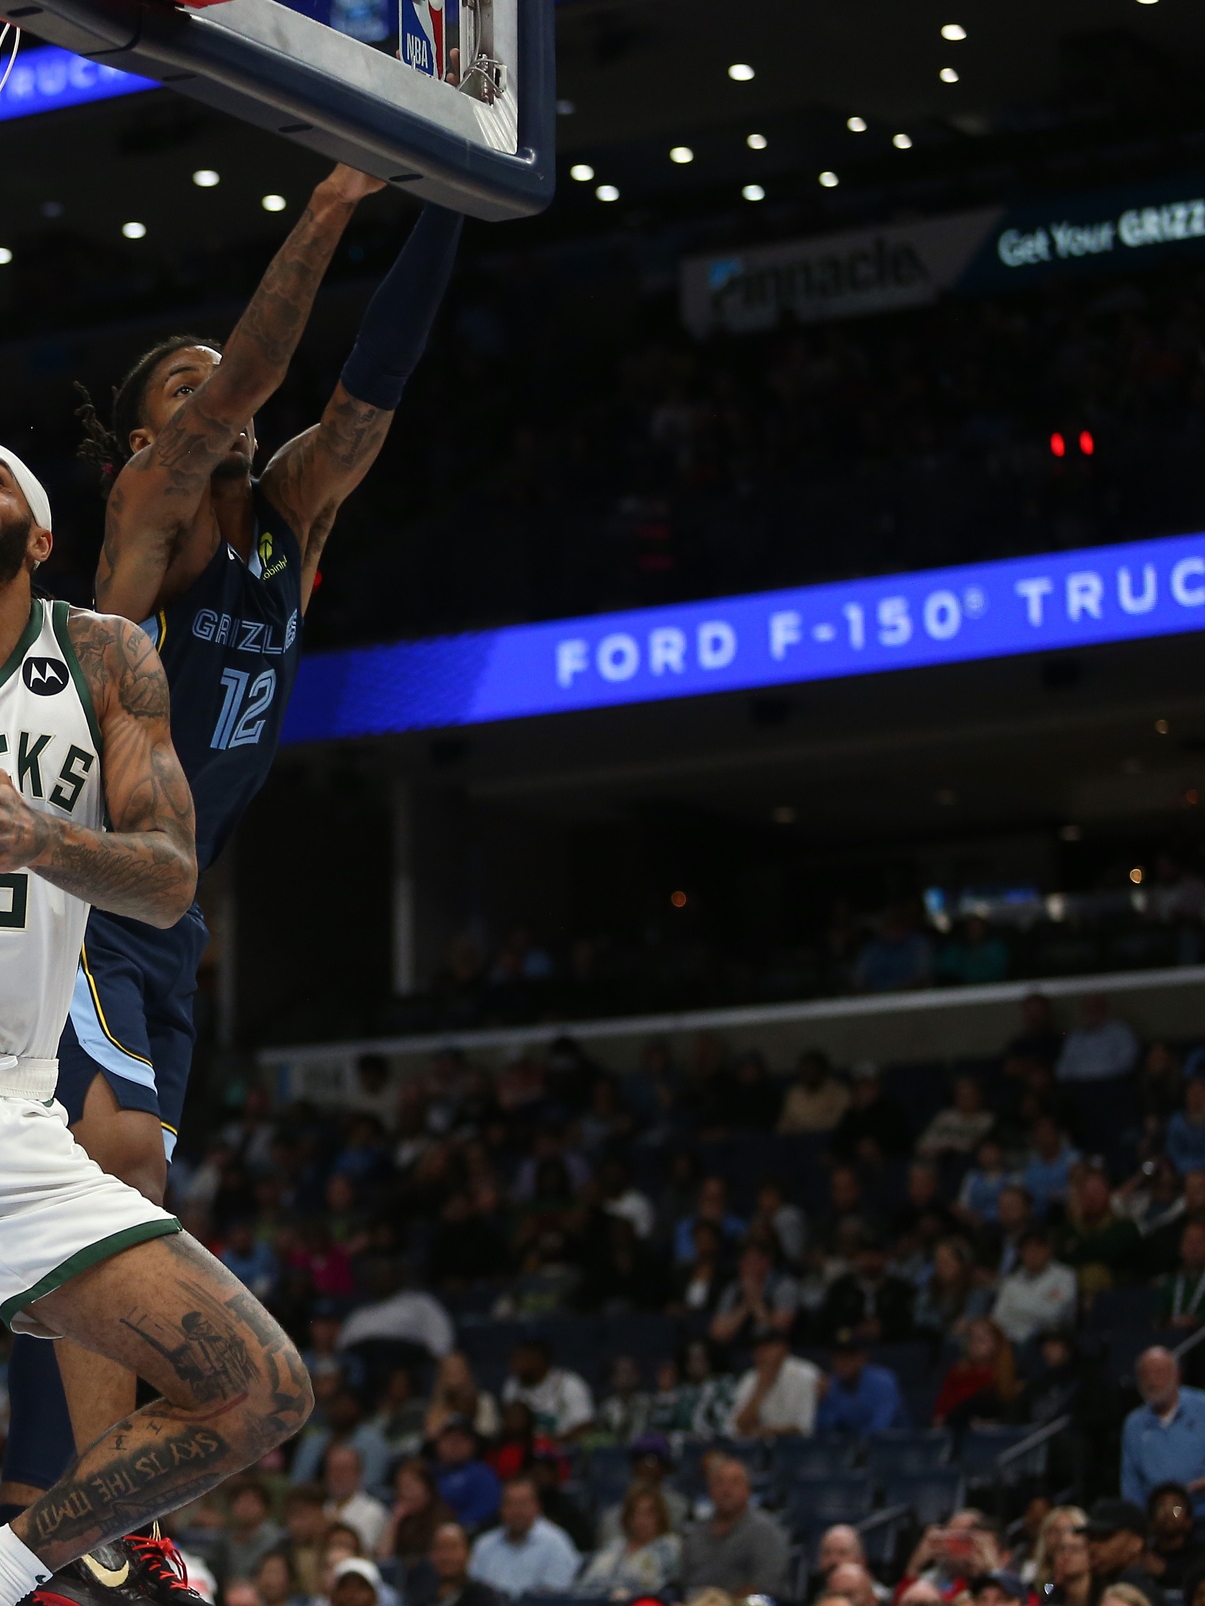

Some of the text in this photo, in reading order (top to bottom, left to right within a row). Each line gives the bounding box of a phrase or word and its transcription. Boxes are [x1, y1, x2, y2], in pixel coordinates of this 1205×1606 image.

[406, 32, 429, 69] NBA
[998, 227, 1051, 266] Get
[1050, 220, 1114, 259] Your
[556, 619, 736, 689] FORD
[210, 666, 276, 750] 12
[90, 1470, 138, 1502] THE
